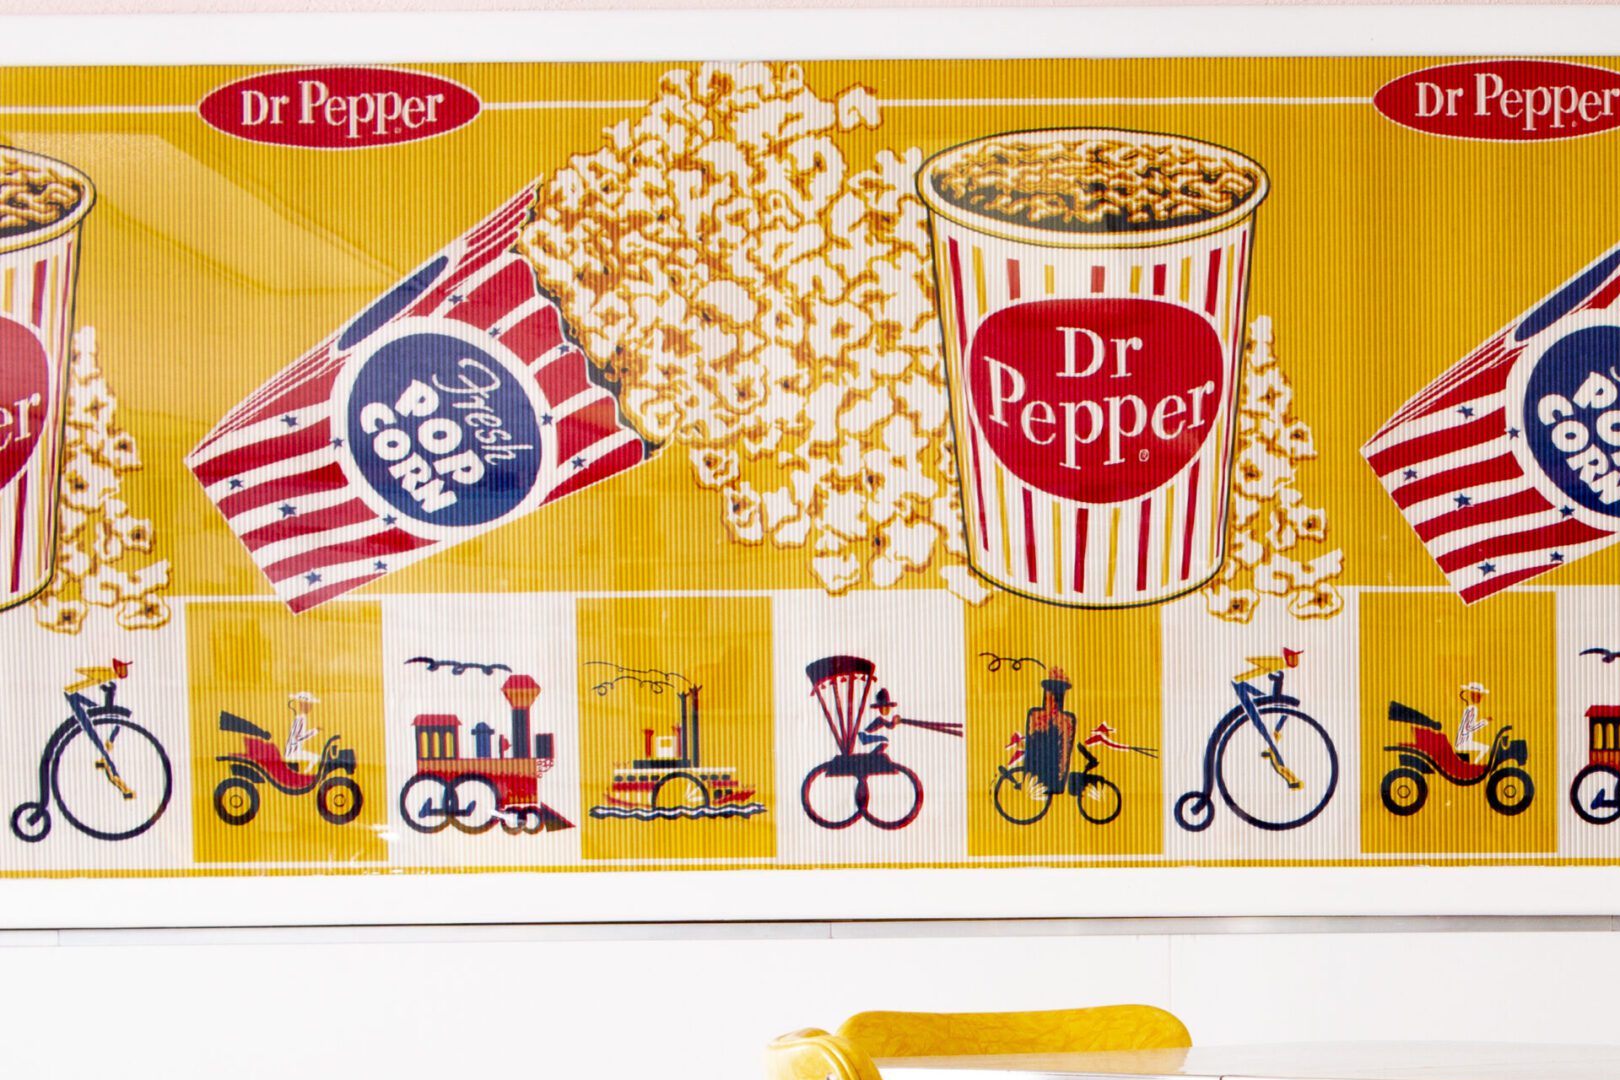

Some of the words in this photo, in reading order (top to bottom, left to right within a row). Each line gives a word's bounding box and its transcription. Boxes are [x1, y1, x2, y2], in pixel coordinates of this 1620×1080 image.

[241, 90, 290, 126] Dr
[298, 80, 444, 138] Pepper
[1415, 82, 1464, 117] Dr
[1474, 73, 1620, 131] Pepper
[1056, 326, 1143, 378] Dr
[360, 402, 457, 513] CORN
[394, 379, 485, 485] POP
[432, 358, 534, 465] Fresh
[983, 355, 1215, 470] Pepper
